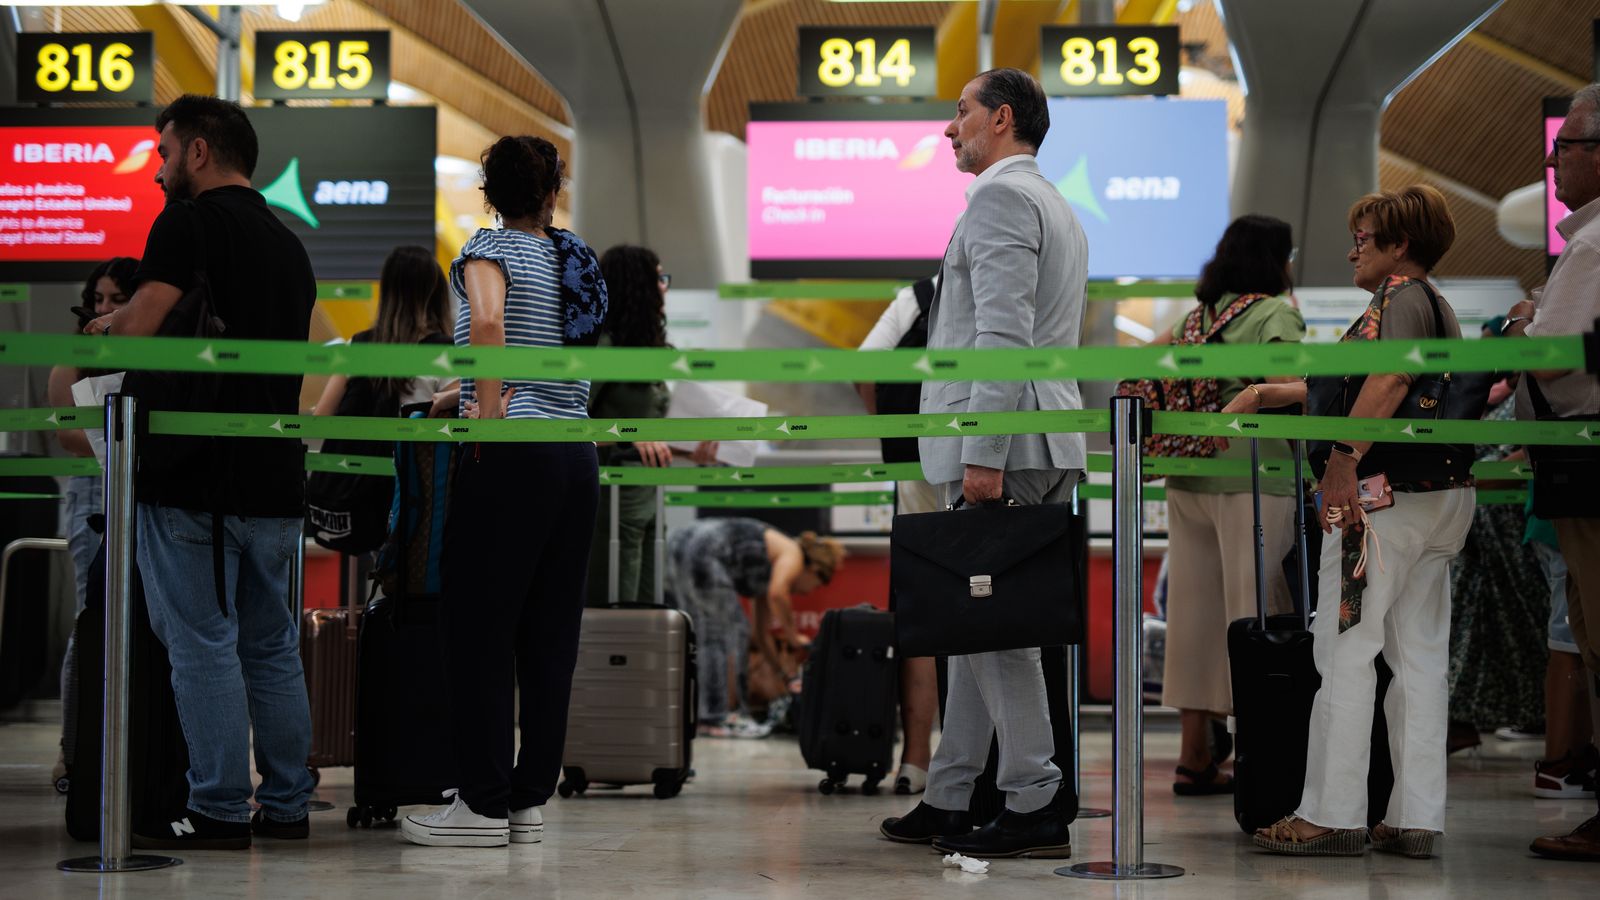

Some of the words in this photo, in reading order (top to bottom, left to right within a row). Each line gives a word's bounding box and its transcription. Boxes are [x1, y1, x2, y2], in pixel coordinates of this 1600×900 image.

[36, 42, 135, 92] 816
[272, 40, 373, 90] 815
[818, 38, 916, 87] 814
[1060, 37, 1161, 86] 813
[14, 143, 115, 163] IBERIA
[794, 138, 899, 160] IBERIA
[314, 180, 389, 204] aena
[1105, 176, 1180, 200] aena
[59, 413, 76, 422] aena
[283, 422, 300, 430] aena
[790, 423, 808, 431] aena
[961, 419, 978, 427] aena
[1241, 421, 1259, 429] aena
[170, 817, 195, 836] N
